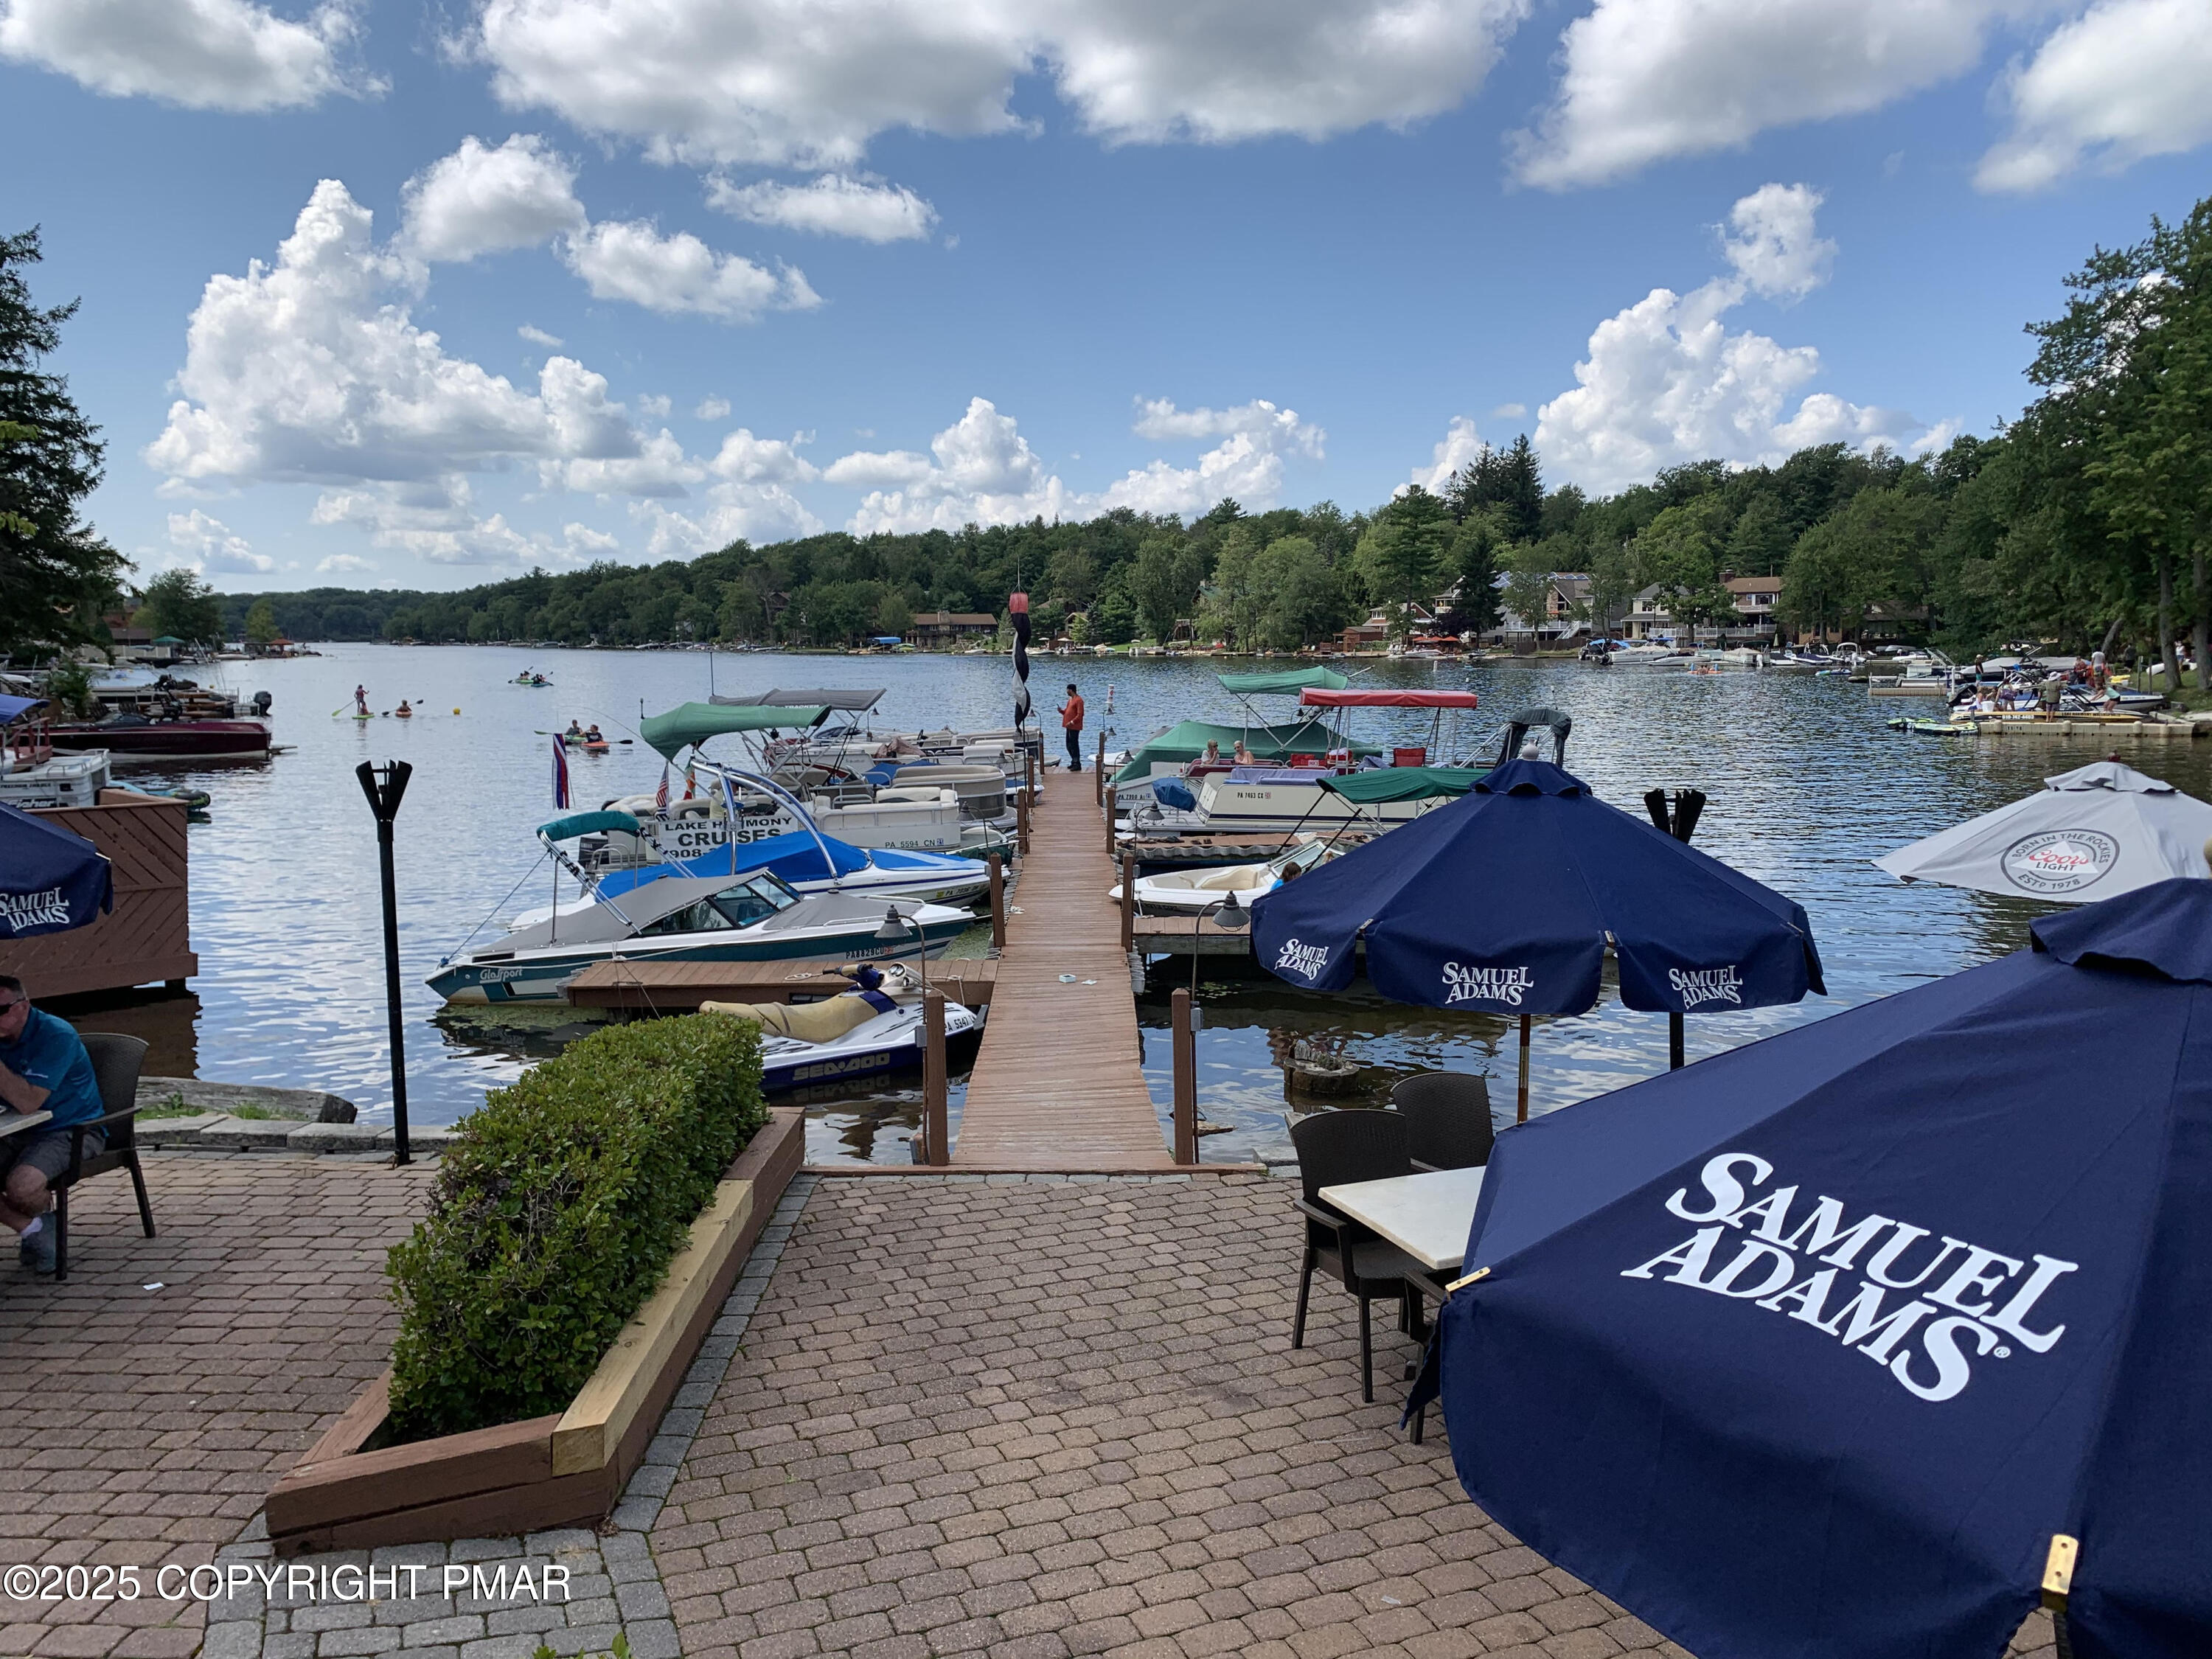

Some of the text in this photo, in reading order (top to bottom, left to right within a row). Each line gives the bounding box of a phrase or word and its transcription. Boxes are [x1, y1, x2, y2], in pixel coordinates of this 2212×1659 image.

[665, 817, 792, 831] LAKE HMONY
[678, 829, 780, 846] CRUSES
[900, 840, 919, 848] 5594
[2011, 839, 2039, 858] BORN
[2042, 835, 2056, 843] IN
[2086, 835, 2112, 863] ROCKIES
[2028, 849, 2089, 865] Coors
[2036, 862, 2076, 871] LIGHT
[2052, 878, 2081, 889] 1978
[0, 887, 69, 916] SAMUEL
[7, 906, 70, 932] ADAMS
[1279, 939, 1329, 966] SAMUEL
[1274, 954, 1321, 981] ADAMS
[1442, 961, 1534, 988] SAMUEL
[1669, 965, 1743, 991] SAMUEL
[1445, 983, 1525, 1006] ADAMS
[1682, 984, 1742, 1010] ADAMS
[953, 1017, 970, 1029] 5347
[1665, 1152, 2079, 1354] SAMUEL
